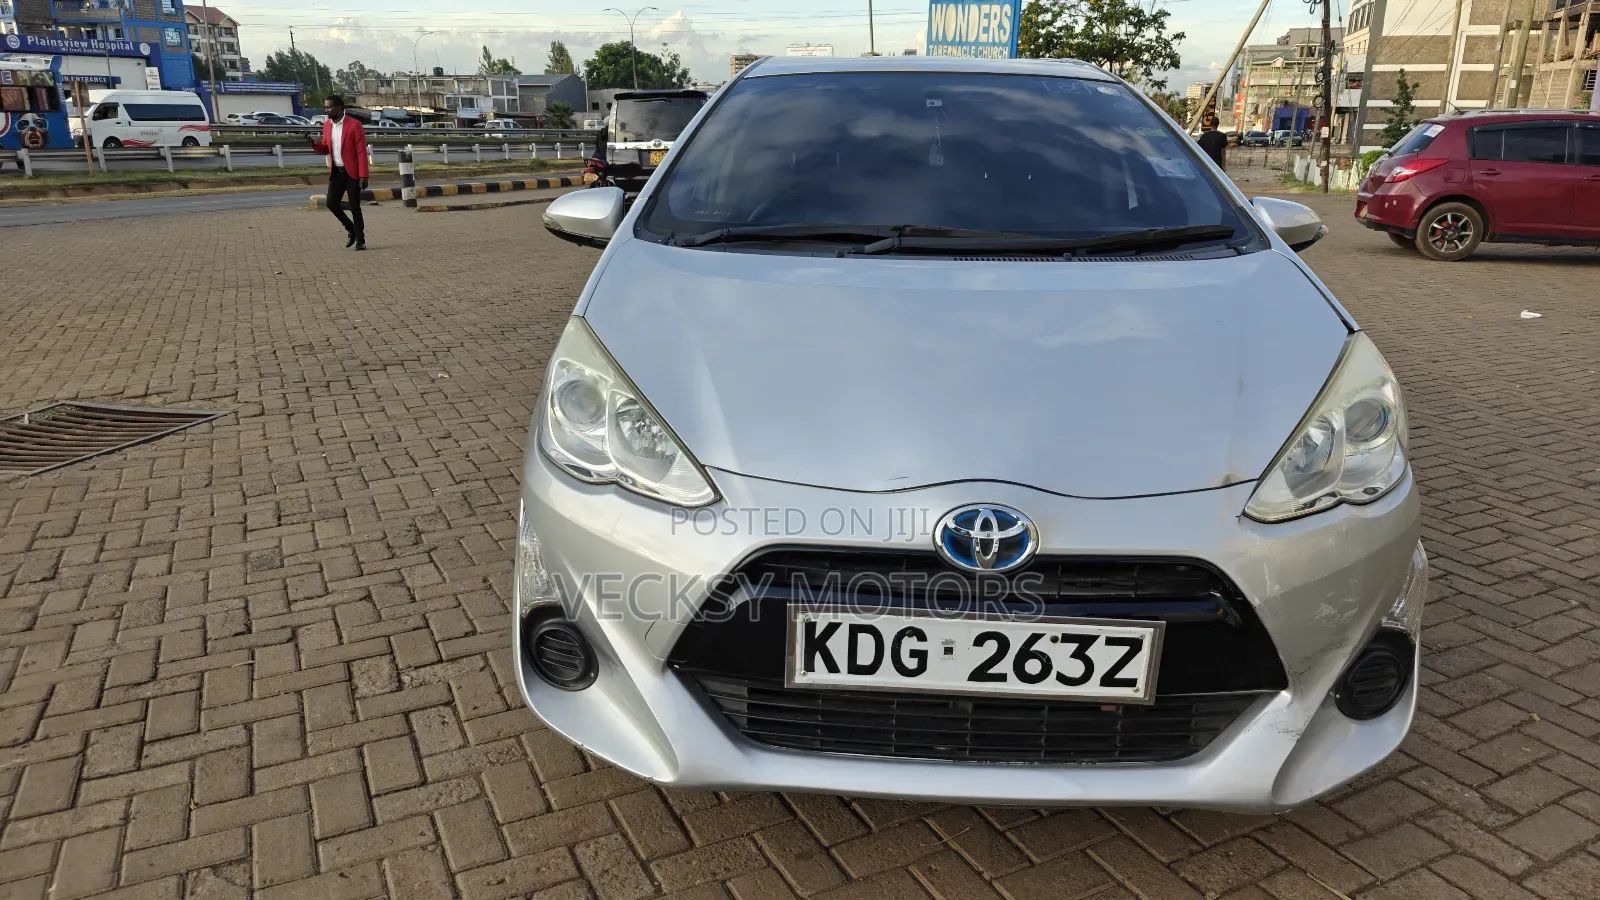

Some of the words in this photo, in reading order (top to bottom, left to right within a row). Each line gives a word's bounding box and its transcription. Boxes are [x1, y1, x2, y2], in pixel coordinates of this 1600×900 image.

[931, 3, 1012, 43] WONDERS
[27, 36, 88, 49] Plainsview
[91, 39, 134, 52] Hospital
[928, 44, 976, 58] TABERNACLE
[977, 45, 1009, 59] CHURCH
[803, 620, 929, 678] KDG
[967, 630, 1144, 688] 263Z
